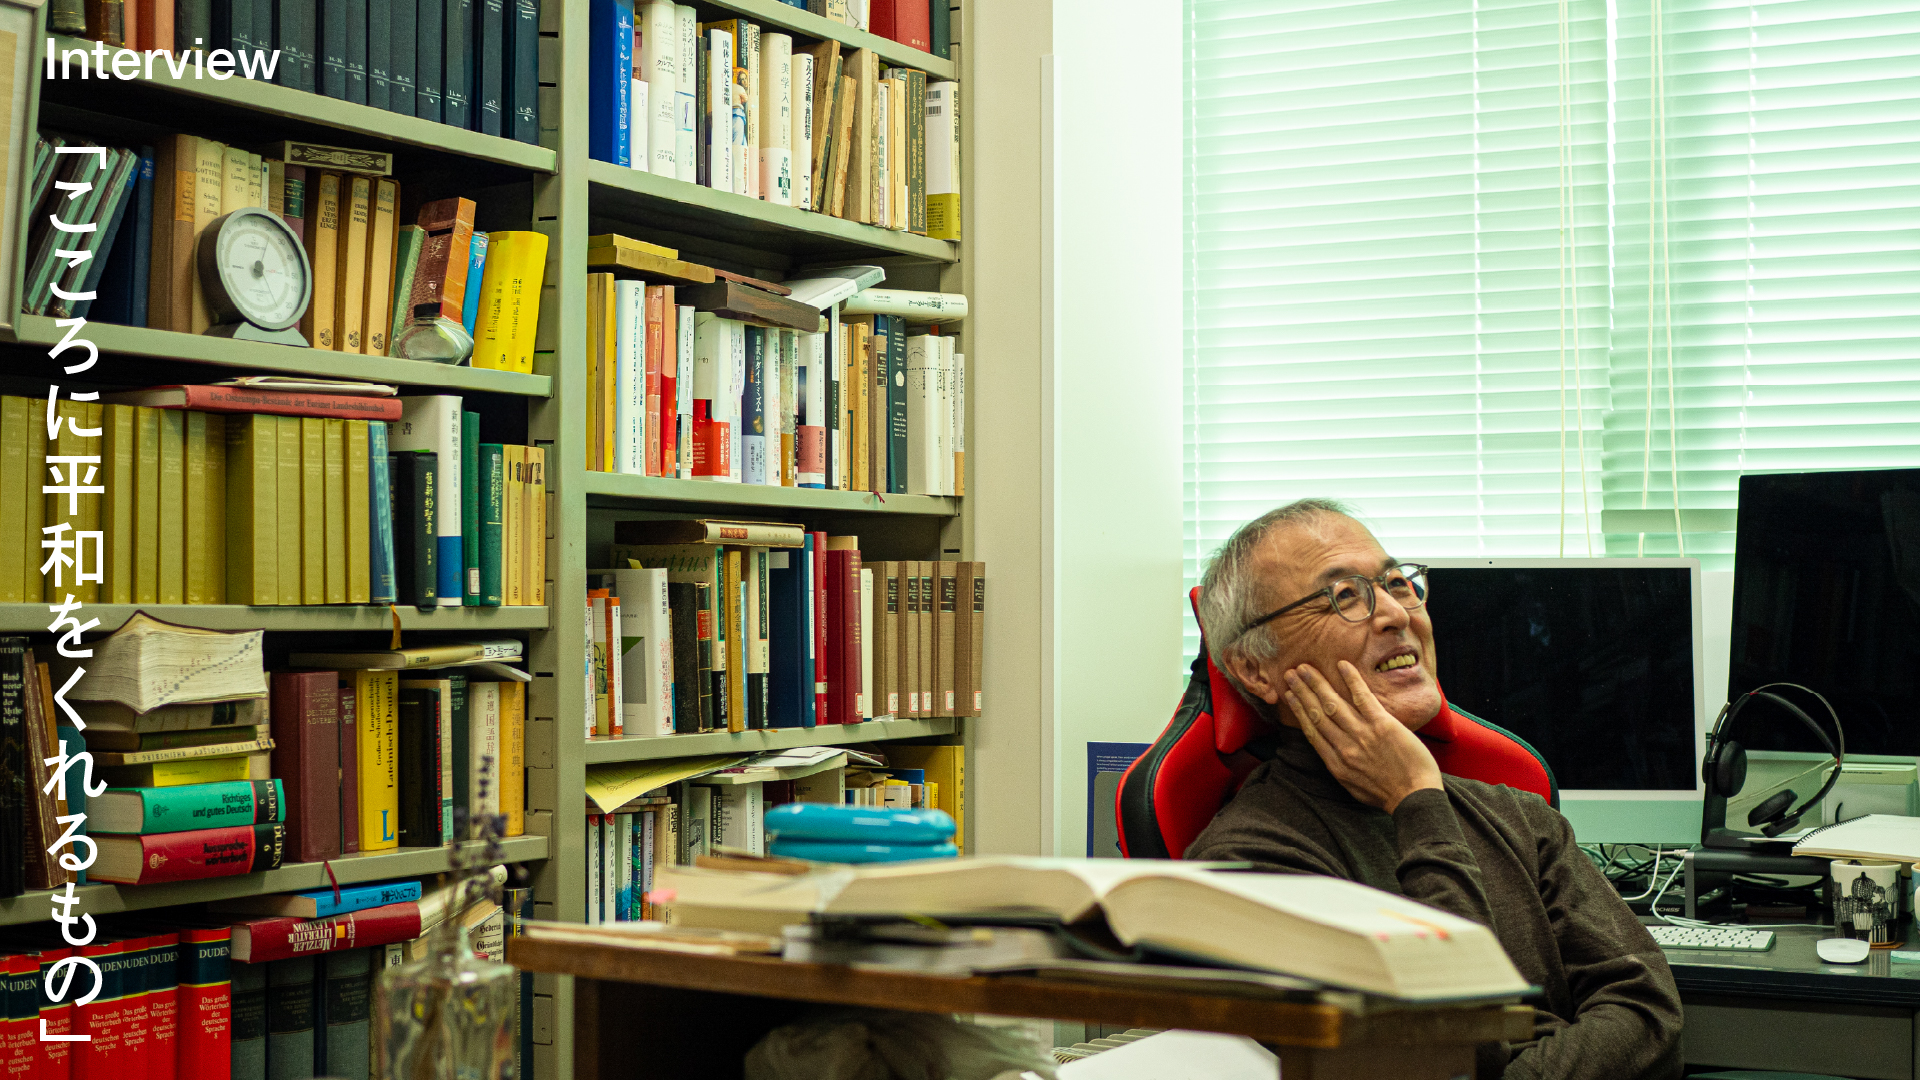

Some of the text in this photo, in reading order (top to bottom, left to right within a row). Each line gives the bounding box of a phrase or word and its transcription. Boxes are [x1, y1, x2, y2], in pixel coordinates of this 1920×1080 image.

[781, 62, 790, 118] 美学入門
[194, 744, 235, 756] TUCHOLSKY
[142, 751, 186, 761] RHEINSBERG
[222, 794, 251, 805] Richtiges
[266, 781, 275, 821] DUDEN
[193, 804, 252, 818] und gutes Deutsch
[382, 810, 394, 841] L
[272, 826, 282, 867] DUDEN
[205, 852, 248, 866] wörterbuch
[293, 921, 328, 933] LEXIKON
[288, 928, 332, 943] LITERATUR
[292, 938, 331, 952] METZLER
[199, 946, 230, 958] DUDEN
[9, 979, 37, 992] UDEN
[214, 995, 228, 1003] große
[133, 1006, 146, 1015] große
[199, 1002, 230, 1011] Wörterbuch
[105, 1011, 120, 1020] große
[123, 1013, 148, 1023] örterbuch
[89, 1018, 121, 1029] Wörterbuch
[202, 1017, 228, 1026] deutschen
[205, 1024, 225, 1033] Sprache
[8, 1038, 36, 1048] örterbuch
[92, 1034, 119, 1045] deutschen
[125, 1037, 145, 1046] Sprache
[95, 1043, 116, 1052] Sprache
[8, 1055, 33, 1065] eutschen
